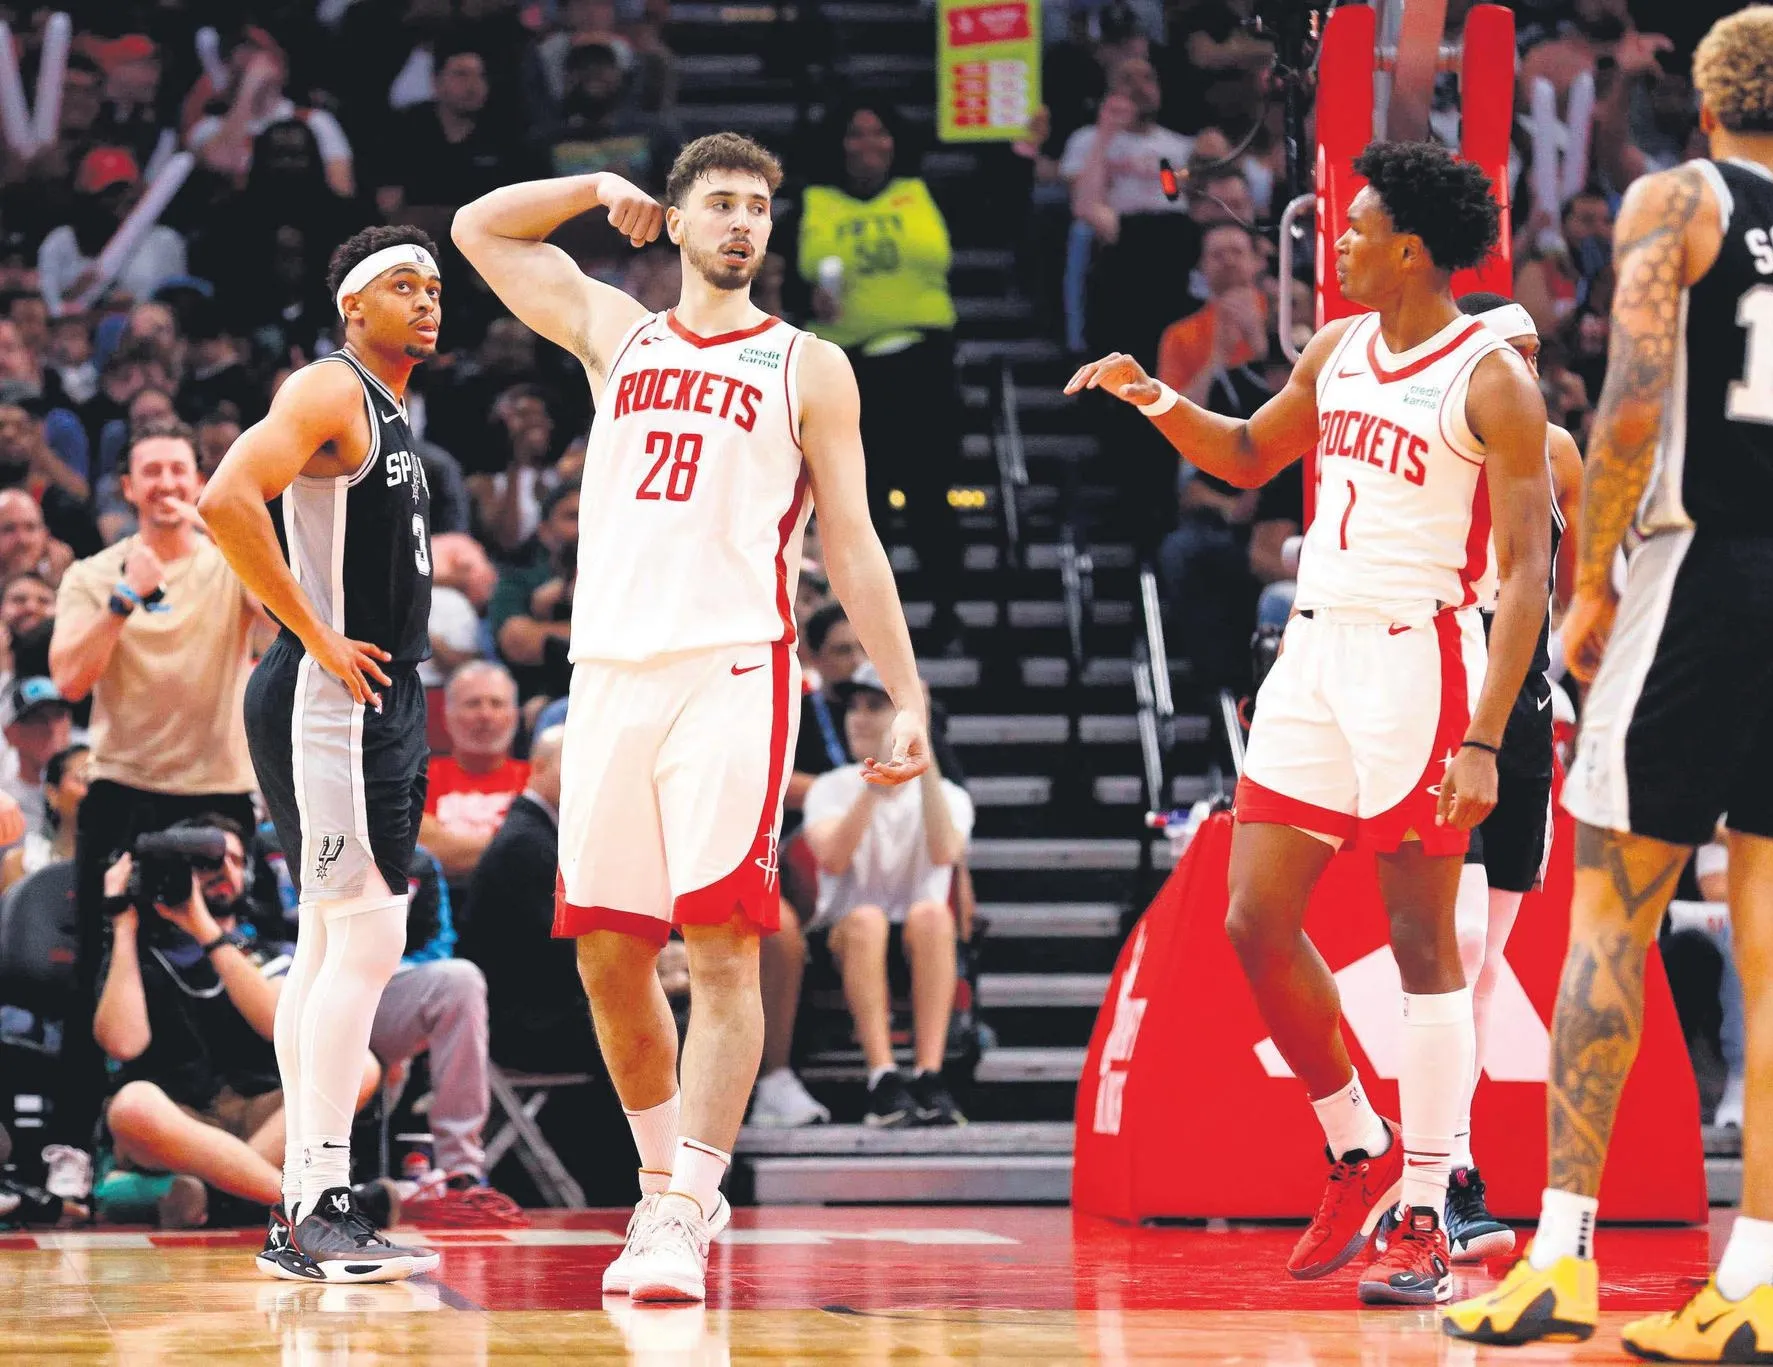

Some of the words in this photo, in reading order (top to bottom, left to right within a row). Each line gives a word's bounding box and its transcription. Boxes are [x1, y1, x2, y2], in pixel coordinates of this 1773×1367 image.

[738, 353, 778, 369] karma
[743, 347, 781, 361] credit
[614, 368, 763, 433] ROCKETS
[1402, 393, 1438, 410] karma
[1410, 384, 1442, 398] credit
[635, 431, 704, 502] 28
[1339, 479, 1357, 550] 1
[411, 512, 431, 577] 3
